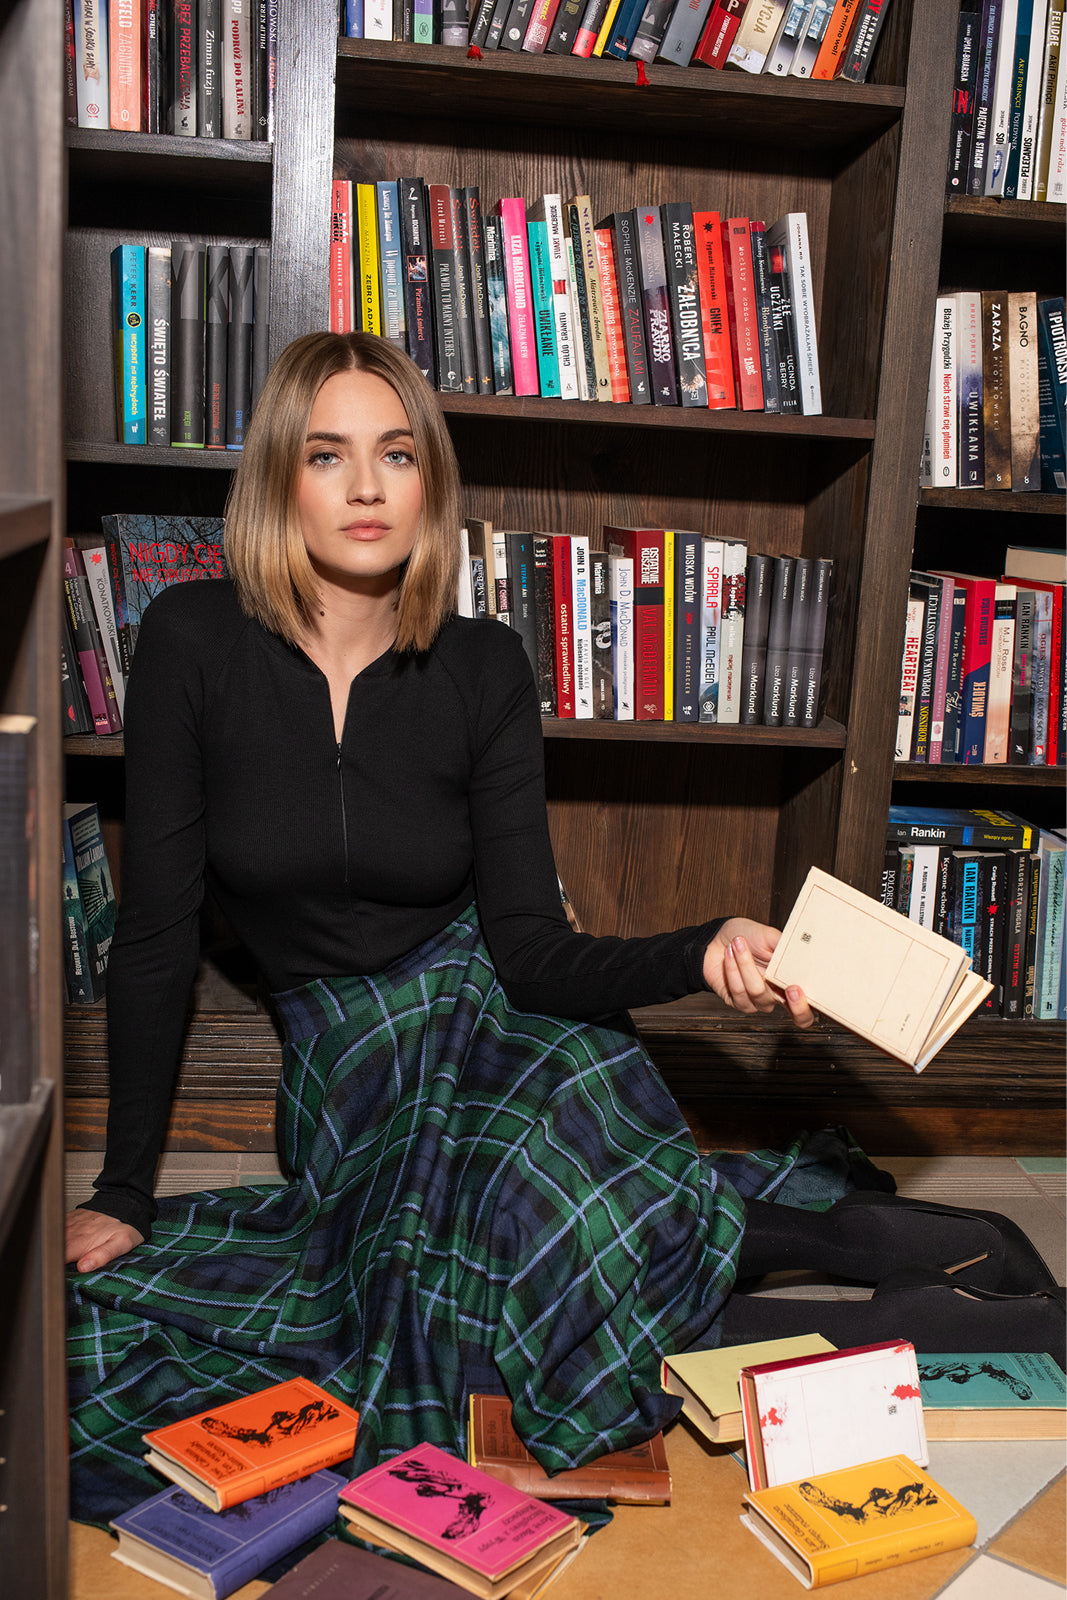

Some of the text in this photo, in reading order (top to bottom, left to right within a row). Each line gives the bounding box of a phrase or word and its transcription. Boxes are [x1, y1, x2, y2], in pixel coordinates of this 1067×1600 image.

[119, 33, 132, 85] ZAGINIONY
[180, 3, 191, 110] BEZ PRZEBACZENIA
[861, 16, 878, 58] ZYGMUNT
[1045, 11, 1061, 105] FELIDAE Akif Pirinçci
[203, 30, 215, 95] Zimna fuzja
[232, 20, 244, 115] PODRÓŻ DO KALINA
[1015, 77, 1024, 108] PIRINÇCI
[973, 106, 988, 168] PAJĘCZYNA STRACHU
[1011, 112, 1021, 150] POJEDYNEK
[1056, 117, 1067, 173] gdzie rdza
[1021, 138, 1032, 177] PELECANOS
[332, 213, 348, 244] MRÓZ
[437, 199, 445, 217] Jacek
[486, 226, 497, 261] Marinina
[672, 222, 683, 268] MAŁECKI
[682, 224, 693, 265] ROBERT
[383, 259, 403, 339] pogoni za milionami
[459, 282, 467, 318] McDowell
[476, 282, 485, 318] McDowell
[510, 235, 529, 358] LIZA MARKLUND KREW
[550, 205, 571, 367] CHŁÓD GRANITU STUART MACBRIDE
[600, 254, 616, 324] BRUTALNA PRAWDA
[621, 220, 644, 375] SOPHIE McKENZIE ZAUFAJ MI
[705, 241, 723, 334] Zygmunt GNIEW
[770, 286, 783, 331] UCZYNKI
[781, 299, 792, 317] ZŁE
[415, 288, 424, 341] Piramida śmierci
[439, 263, 455, 357] PRAWDA TO MARNY INTERES
[589, 279, 602, 341] Mistrzowie zbrodni
[677, 285, 701, 361] ŻAŁOBNICA
[761, 307, 772, 347] Blondynka
[803, 300, 812, 351] WYOBRAŻAŁAM
[991, 303, 1001, 351] ZARAZA
[1019, 306, 1029, 348] BAGNO
[130, 333, 138, 364] INCYDENT
[539, 310, 554, 357] UWIKŁANIE
[649, 309, 663, 363] PRAWDY
[658, 309, 671, 362] ZIARNO
[151, 319, 169, 421] ŚWIĘTO ŚWIATEŁ
[779, 362, 787, 389] BERRY
[786, 355, 796, 391] LUCINDA
[806, 353, 814, 376] ŚMIERĆ
[941, 308, 952, 460] Błażej Przygodzki Niech strawi cię płomień
[968, 391, 979, 461] UWIKŁANA
[130, 543, 222, 568] NIGDY CIĘ
[133, 568, 154, 582] NIE
[576, 547, 585, 565] JOHN
[594, 562, 603, 594] Marinina
[640, 547, 650, 584] KUSZENIE
[649, 547, 659, 584] OSTATNIE
[685, 544, 695, 575] WIOSKA
[499, 579, 508, 611] SPY CHANNEL
[576, 579, 587, 630] MacDONALD
[619, 568, 631, 599] JOHN D.
[685, 578, 697, 603] WDÓW
[95, 578, 116, 637] KONATKOWSKI
[706, 566, 720, 647] SPIRALA PAUL
[1021, 602, 1031, 616] IAN
[560, 604, 571, 695] ostatni sprawiedliwy
[642, 609, 658, 696] VAL McDERMID
[951, 632, 961, 681] Piotr Rowicki
[1001, 627, 1011, 672] M.J. Rose
[1020, 619, 1029, 649] RANKIN
[902, 637, 919, 692] HEARTBEAT
[919, 594, 938, 742] ROBINSON POPRAWKA DO KONSTYTUCJI
[748, 674, 759, 713] Marklund
[771, 677, 781, 717] Marklund
[788, 679, 799, 718] Marklund
[805, 680, 816, 719] Marklund
[969, 682, 986, 717] ŚWIADEK
[910, 827, 946, 838] Rankin
[886, 870, 895, 906] DOLORES
[938, 857, 950, 918] Kręcone schody
[963, 867, 977, 919] IAN RANKIN
[1016, 857, 1025, 906] MAŁGORZATA
